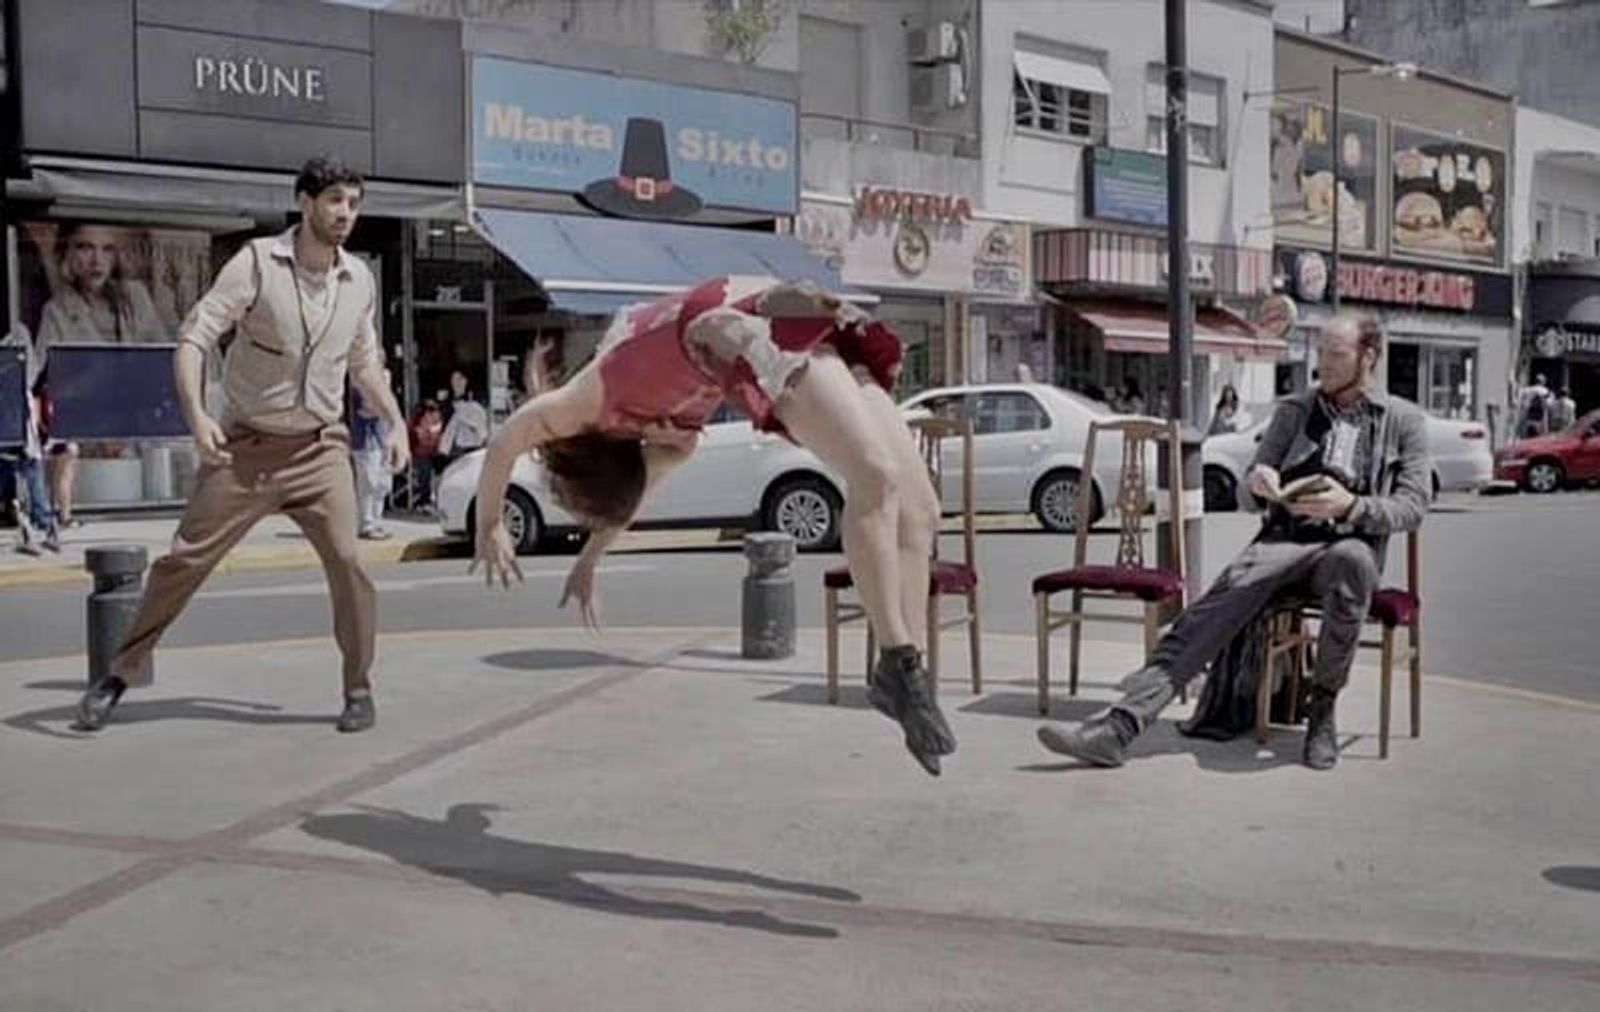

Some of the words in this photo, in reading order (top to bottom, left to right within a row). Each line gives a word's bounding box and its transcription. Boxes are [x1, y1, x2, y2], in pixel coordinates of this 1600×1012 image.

[195, 57, 325, 101] PRÜNE
[484, 101, 613, 150] Marta
[678, 127, 789, 172] Sixto
